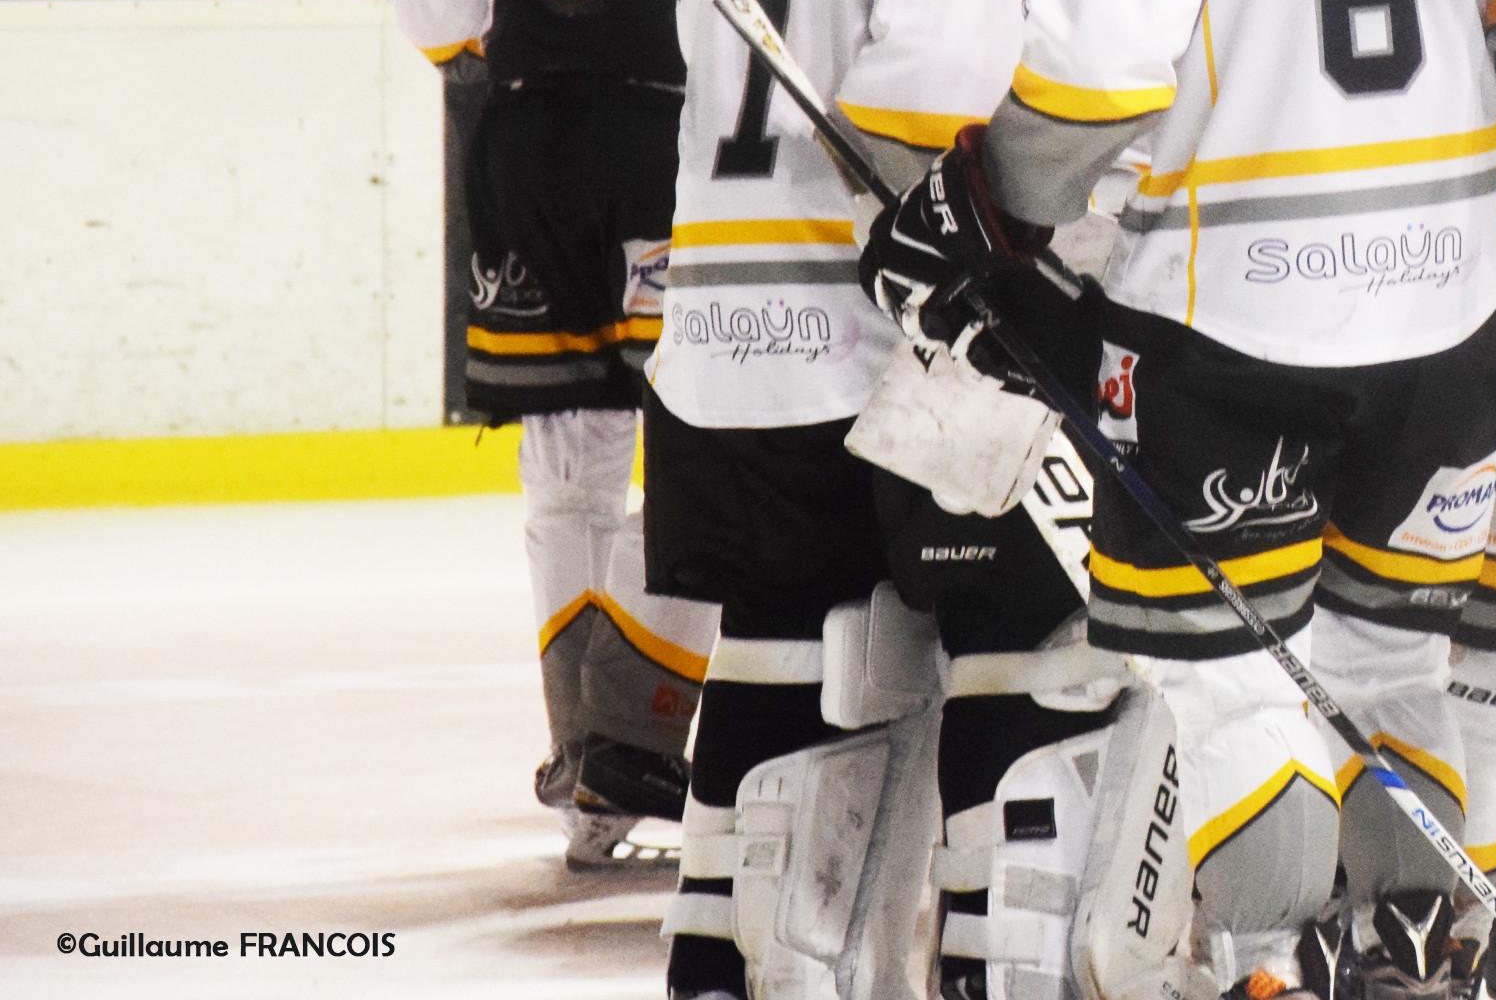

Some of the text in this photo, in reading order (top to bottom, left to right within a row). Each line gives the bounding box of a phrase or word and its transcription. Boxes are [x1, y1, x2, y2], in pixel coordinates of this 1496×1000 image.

[1245, 221, 1463, 285] Salaün
[672, 299, 831, 346] Salaün
[920, 543, 997, 562] BAUER
[1267, 641, 1341, 717] BAUER
[1127, 743, 1180, 940] BAUER
